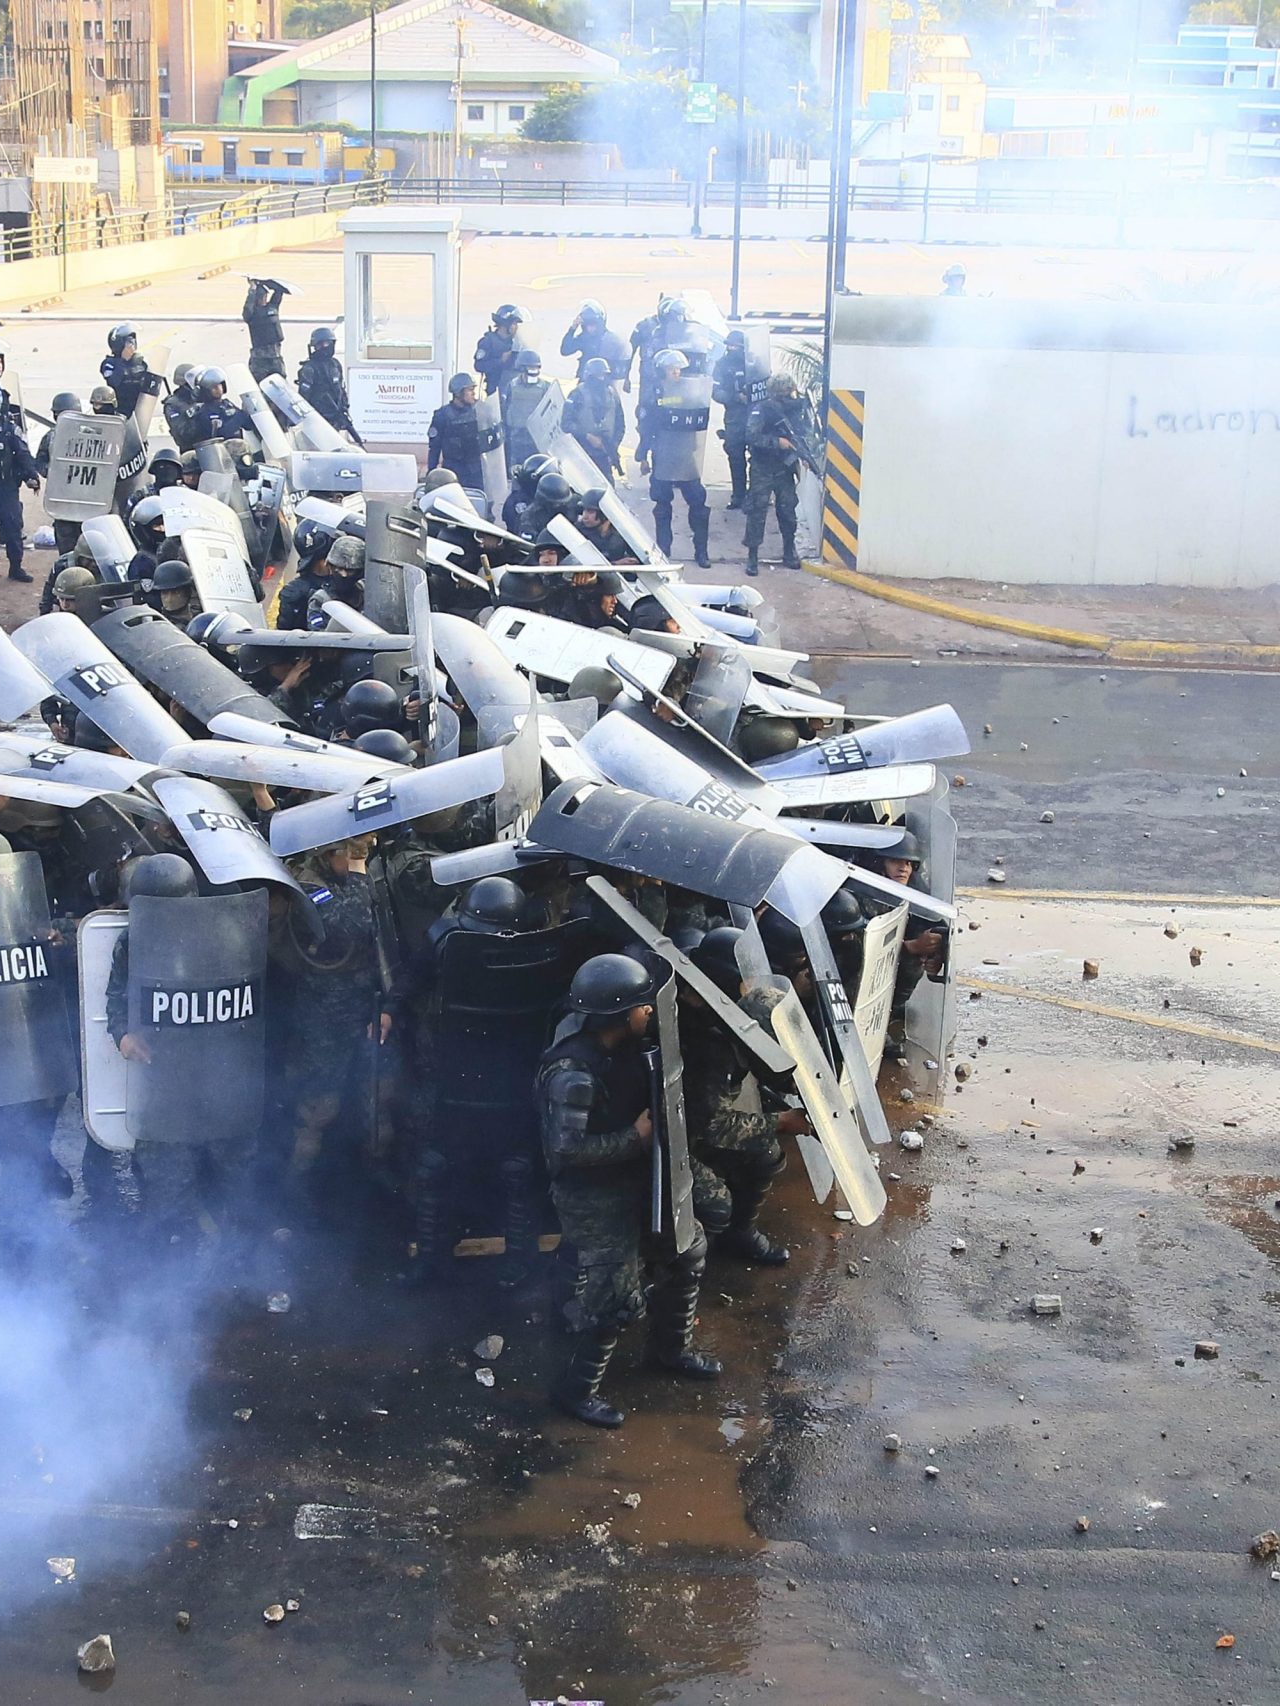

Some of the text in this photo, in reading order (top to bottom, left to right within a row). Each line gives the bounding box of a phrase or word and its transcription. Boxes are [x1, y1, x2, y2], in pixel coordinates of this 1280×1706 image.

[374, 384, 416, 394] Marriott
[67, 465, 98, 485] PM
[152, 984, 255, 1025] POLICIA
